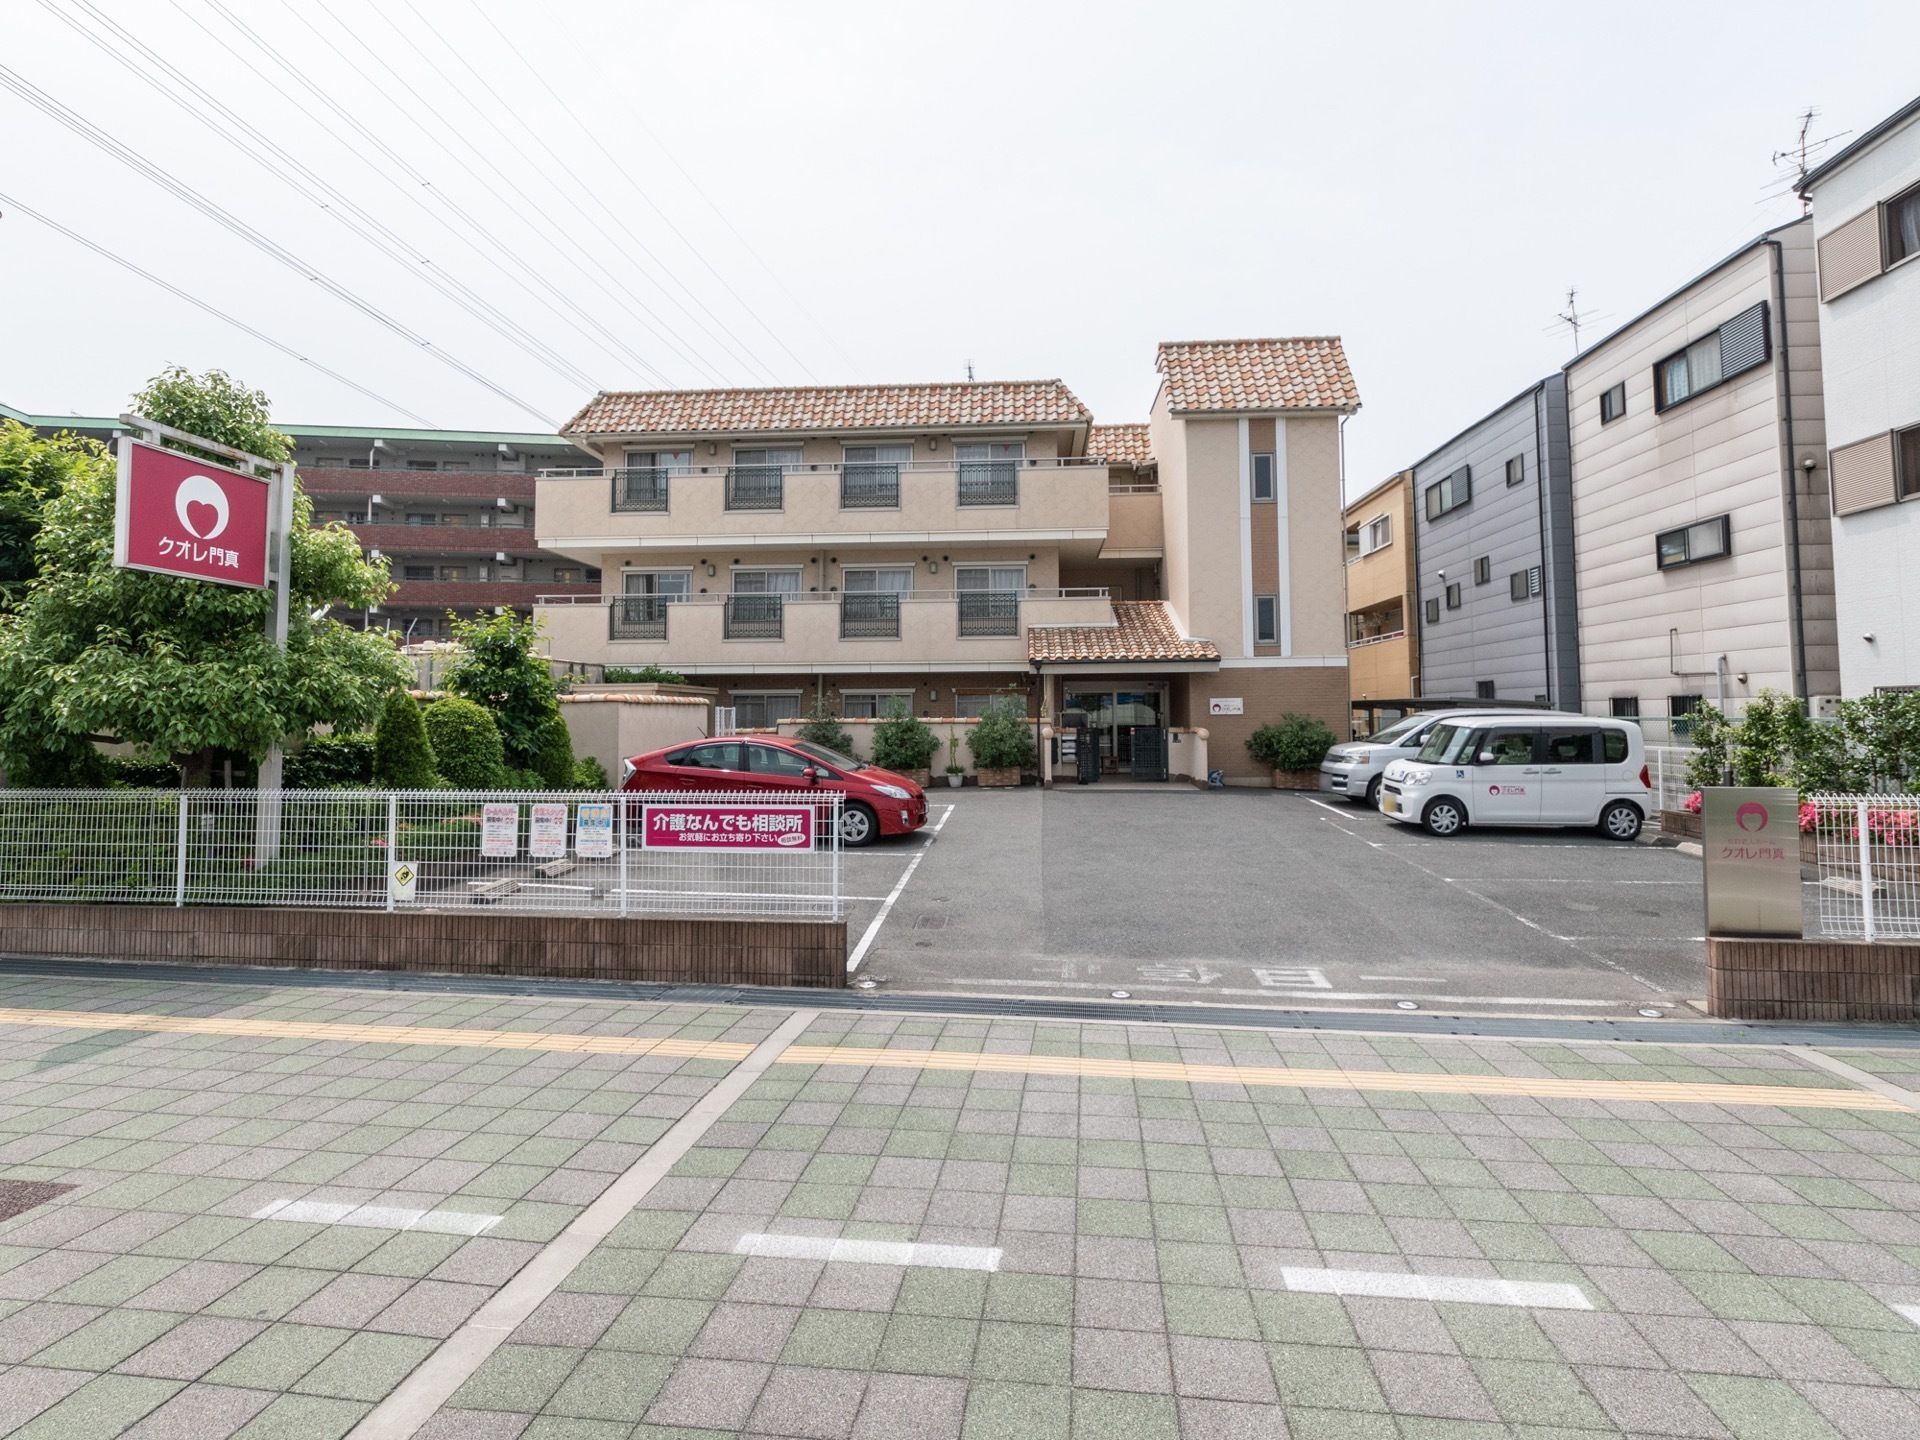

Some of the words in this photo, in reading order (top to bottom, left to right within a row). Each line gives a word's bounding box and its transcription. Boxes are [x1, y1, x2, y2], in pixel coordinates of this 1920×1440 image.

[158, 536, 240, 569] クオレ門真
[653, 813, 803, 833] 介護なんでも相談所
[678, 832, 778, 843] お気軽にお立ち寄り下さい
[1721, 847, 1785, 859] クオレ門真
